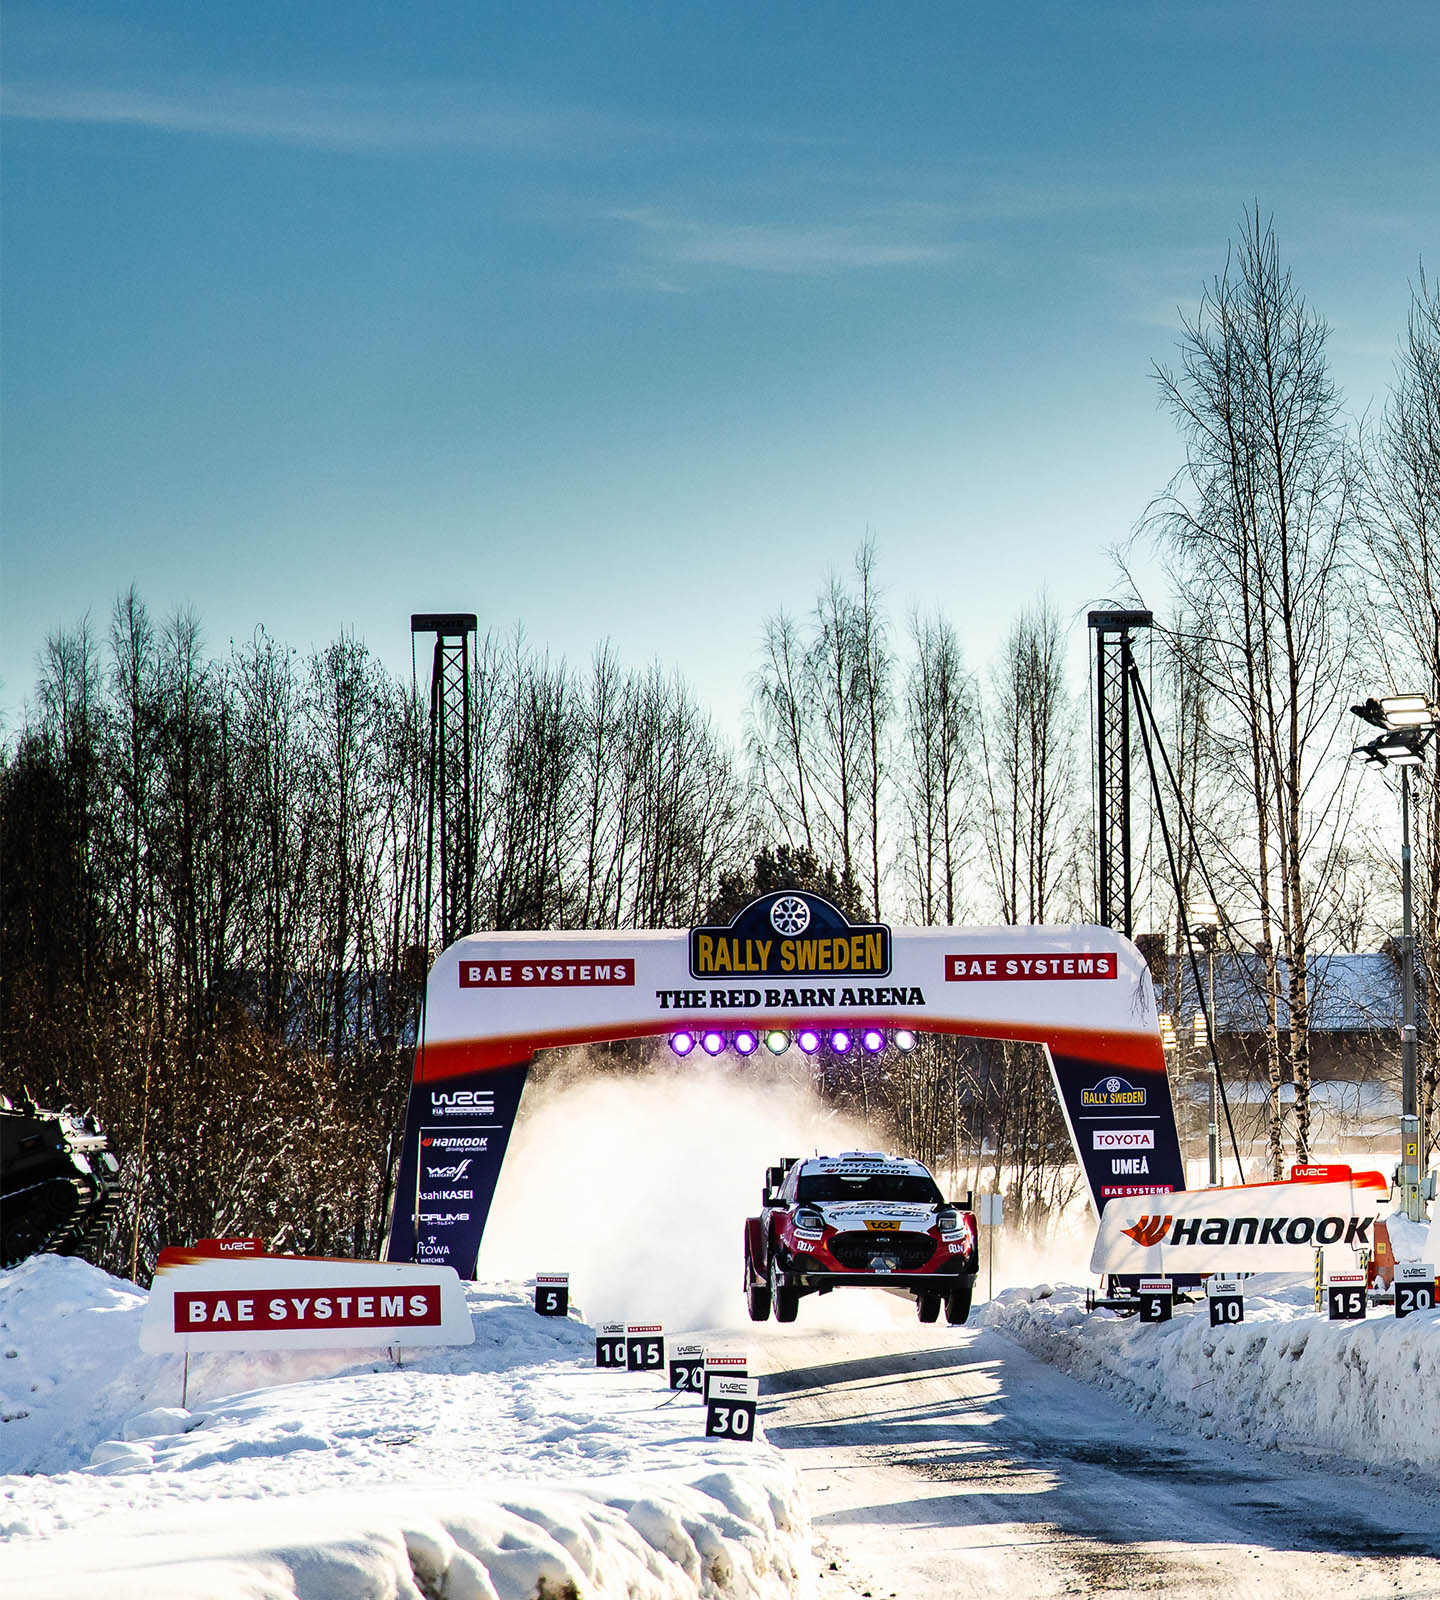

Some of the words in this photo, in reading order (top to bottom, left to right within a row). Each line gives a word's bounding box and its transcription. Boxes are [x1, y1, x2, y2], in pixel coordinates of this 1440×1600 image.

[699, 935, 772, 971] RALLY
[780, 933, 882, 971] SWEDEN
[468, 966, 512, 981] BAE
[521, 965, 627, 981] SYSTEMS
[954, 960, 997, 976] BAE
[1005, 959, 1110, 975] SYSTEMS
[656, 990, 706, 1008] THE
[709, 989, 762, 1008] RED
[764, 988, 836, 1007] BARN
[839, 987, 926, 1006] ARENA
[431, 1091, 495, 1105] WRC
[1083, 1092, 1108, 1104] RALLY
[1110, 1090, 1144, 1104] SWEDEN
[1096, 1135, 1151, 1145] TOYOTA
[1112, 1155, 1149, 1174] UMEÅ
[1295, 1167, 1328, 1176] WRC
[1126, 1187, 1171, 1195] SYSTEMS
[411, 1213, 470, 1221] FORUM8
[871, 1221, 897, 1229] tet
[219, 1241, 255, 1251] WRC
[188, 1299, 254, 1323] BAE
[268, 1295, 428, 1321] SYSTEMS
[546, 1292, 558, 1310] 5
[1151, 1299, 1162, 1317] 5
[1334, 1293, 1361, 1313] 15
[1400, 1289, 1430, 1311] 20
[1214, 1302, 1240, 1321] 10
[601, 1343, 625, 1362] 10
[632, 1344, 660, 1364] 15
[675, 1366, 704, 1389] 20
[720, 1382, 748, 1391] WRC
[712, 1407, 749, 1435] 30
